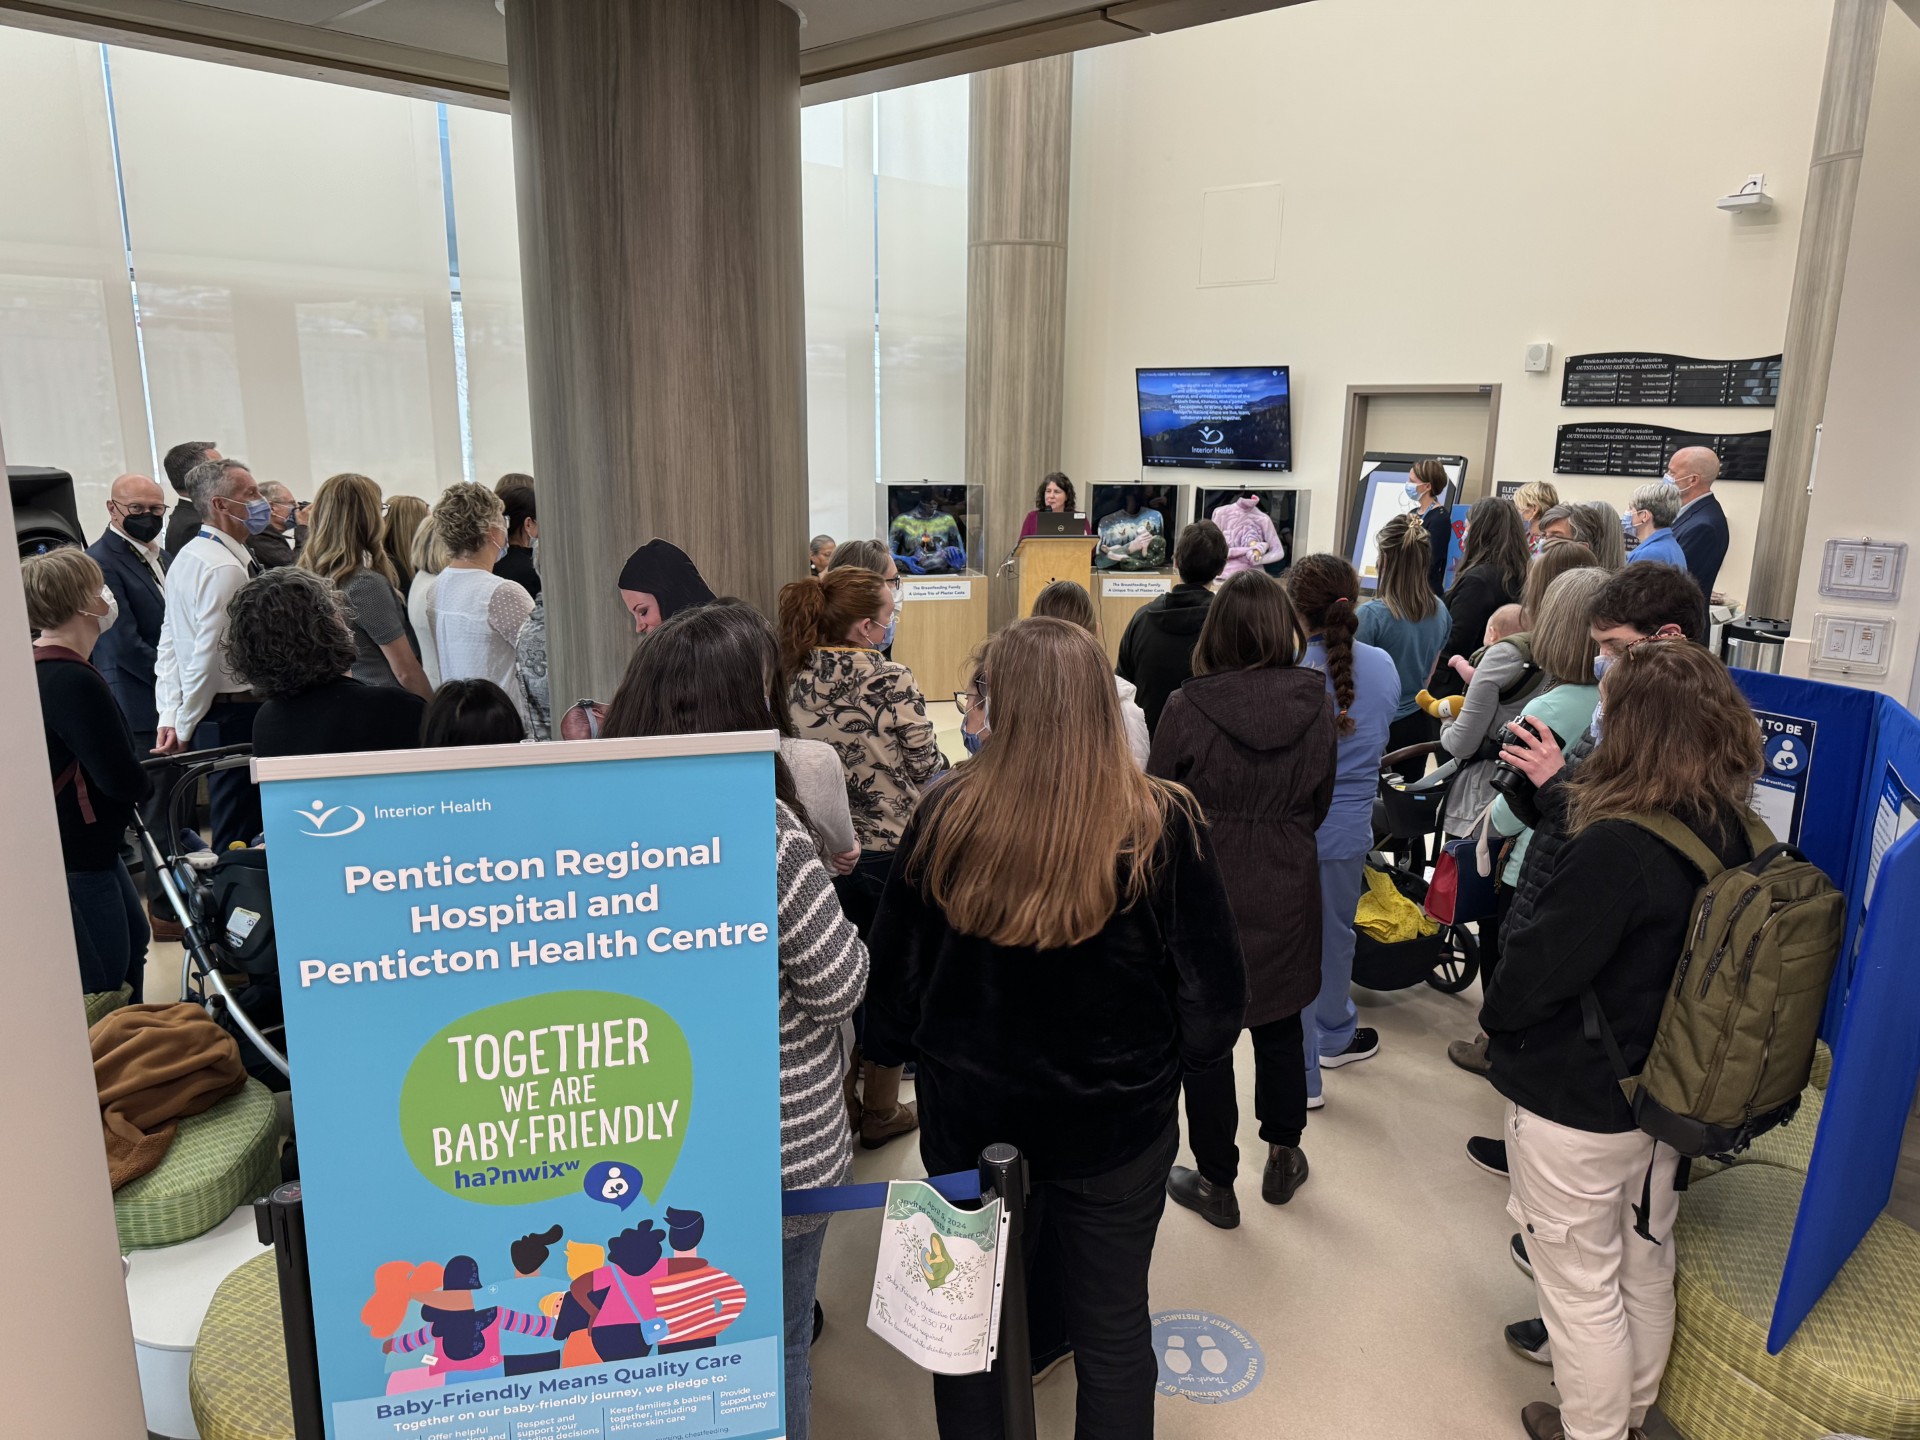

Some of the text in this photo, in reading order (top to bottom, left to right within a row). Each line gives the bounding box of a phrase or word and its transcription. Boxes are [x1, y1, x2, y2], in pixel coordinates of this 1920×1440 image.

[1191, 446, 1234, 455] Interior Health
[1765, 719, 1784, 732] TO
[1785, 724, 1803, 736] BE
[373, 797, 492, 819] Interior Health
[344, 836, 722, 894] Penticton Regional
[410, 884, 660, 934] Hospital and
[299, 920, 769, 987] Penticton Health Centre
[447, 1017, 650, 1083] TOGETHER
[500, 1074, 597, 1113] WE ARE
[432, 1099, 680, 1167] BABY-FRIENDLY
[900, 1198, 926, 1214] Invited
[954, 1231, 974, 1239] Staff
[927, 1200, 941, 1214] April
[947, 1217, 967, 1229] 2024
[949, 1312, 984, 1321] Celebration
[1160, 1313, 1200, 1323] DISTANCE
[939, 1322, 953, 1333] PM
[1209, 1319, 1231, 1331] KEEP
[920, 1328, 944, 1343] required
[1229, 1327, 1253, 1350] PLEASE
[1244, 1357, 1258, 1381] PLEASE
[376, 1353, 742, 1419] Baby-Friendly Means Quality Care
[1178, 1374, 1229, 1385] Thank you!
[1231, 1379, 1247, 1393] KEEP
[720, 1386, 751, 1398] Provide
[1164, 1384, 1177, 1393] OF
[1179, 1388, 1223, 1398] DISTANCE
[1222, 1387, 1230, 1395] A
[394, 1374, 728, 1432] Together on our baby-friendly journey, we pledge to:
[610, 1394, 712, 1415] Keep families & babies
[720, 1389, 777, 1407] support to the
[610, 1405, 697, 1423] together, including
[720, 1401, 767, 1415] community
[516, 1413, 575, 1429] Respect and
[610, 1415, 686, 1432] skin-to-skin care
[428, 1432, 453, 1440] Offer
[455, 1426, 489, 1439] helpful
[488, 1432, 506, 1440] and
[517, 1422, 578, 1438] support your
[556, 1427, 600, 1440] decisions
[685, 1427, 729, 1439] chestfeeding
